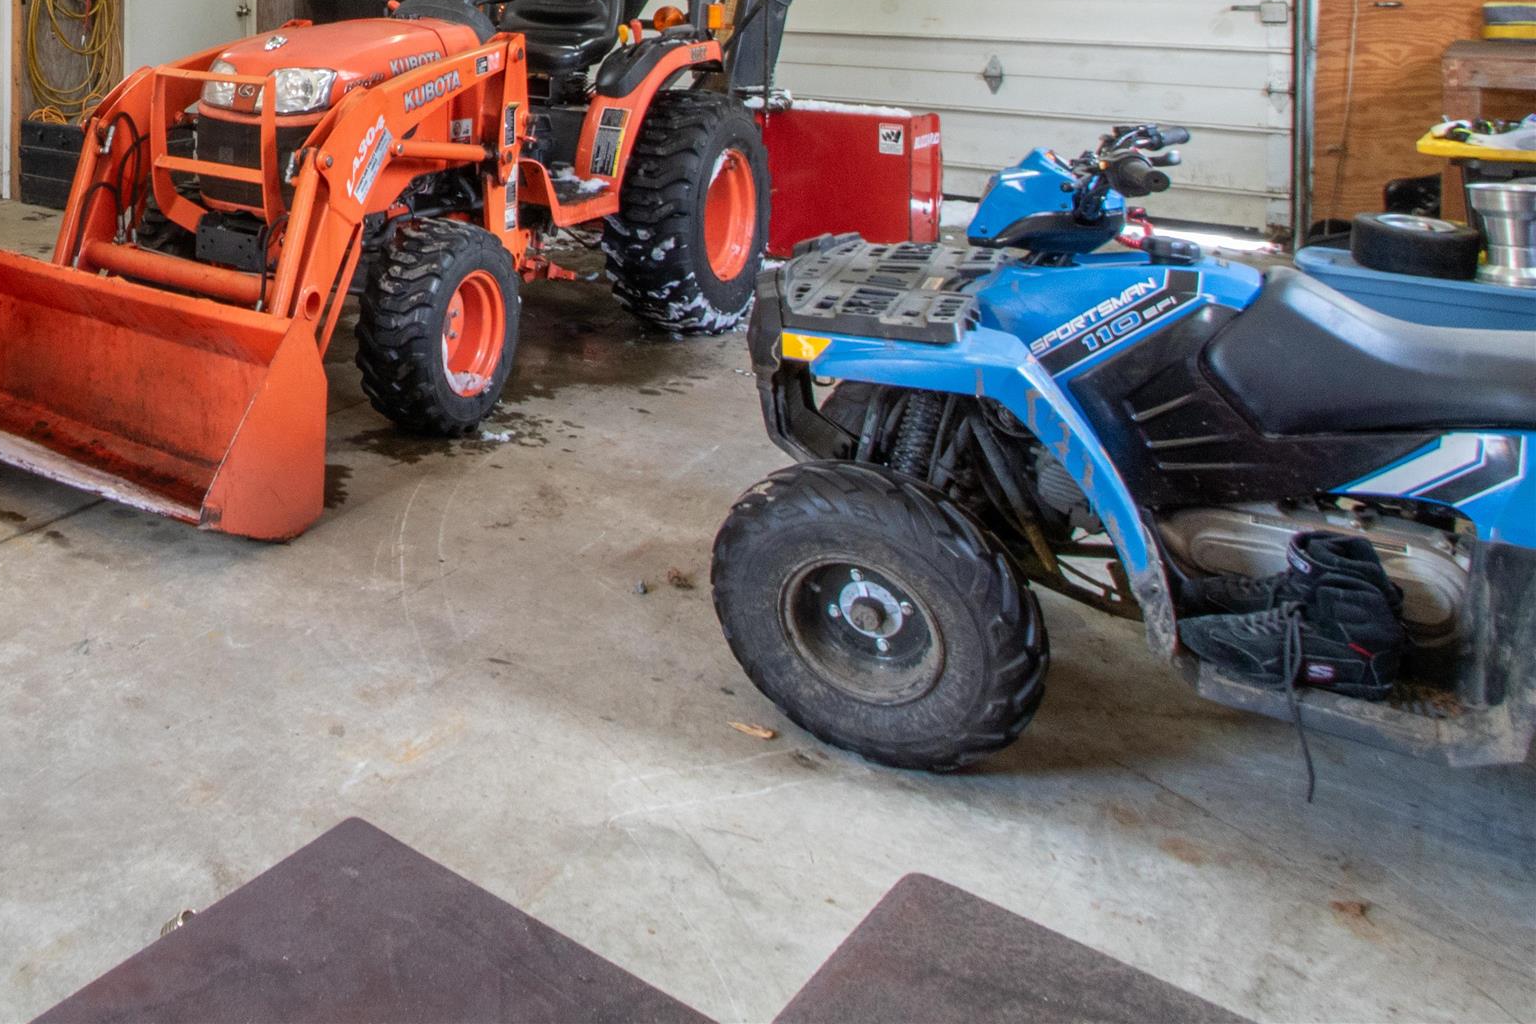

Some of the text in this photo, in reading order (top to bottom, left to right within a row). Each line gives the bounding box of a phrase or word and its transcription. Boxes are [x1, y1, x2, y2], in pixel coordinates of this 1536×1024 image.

[389, 50, 442, 77] KUBOTA
[403, 69, 462, 114] KUBOTA
[346, 114, 386, 198] LA304
[1029, 276, 1158, 354] SPORTSMAN
[1081, 295, 1178, 352] 110 EFI
